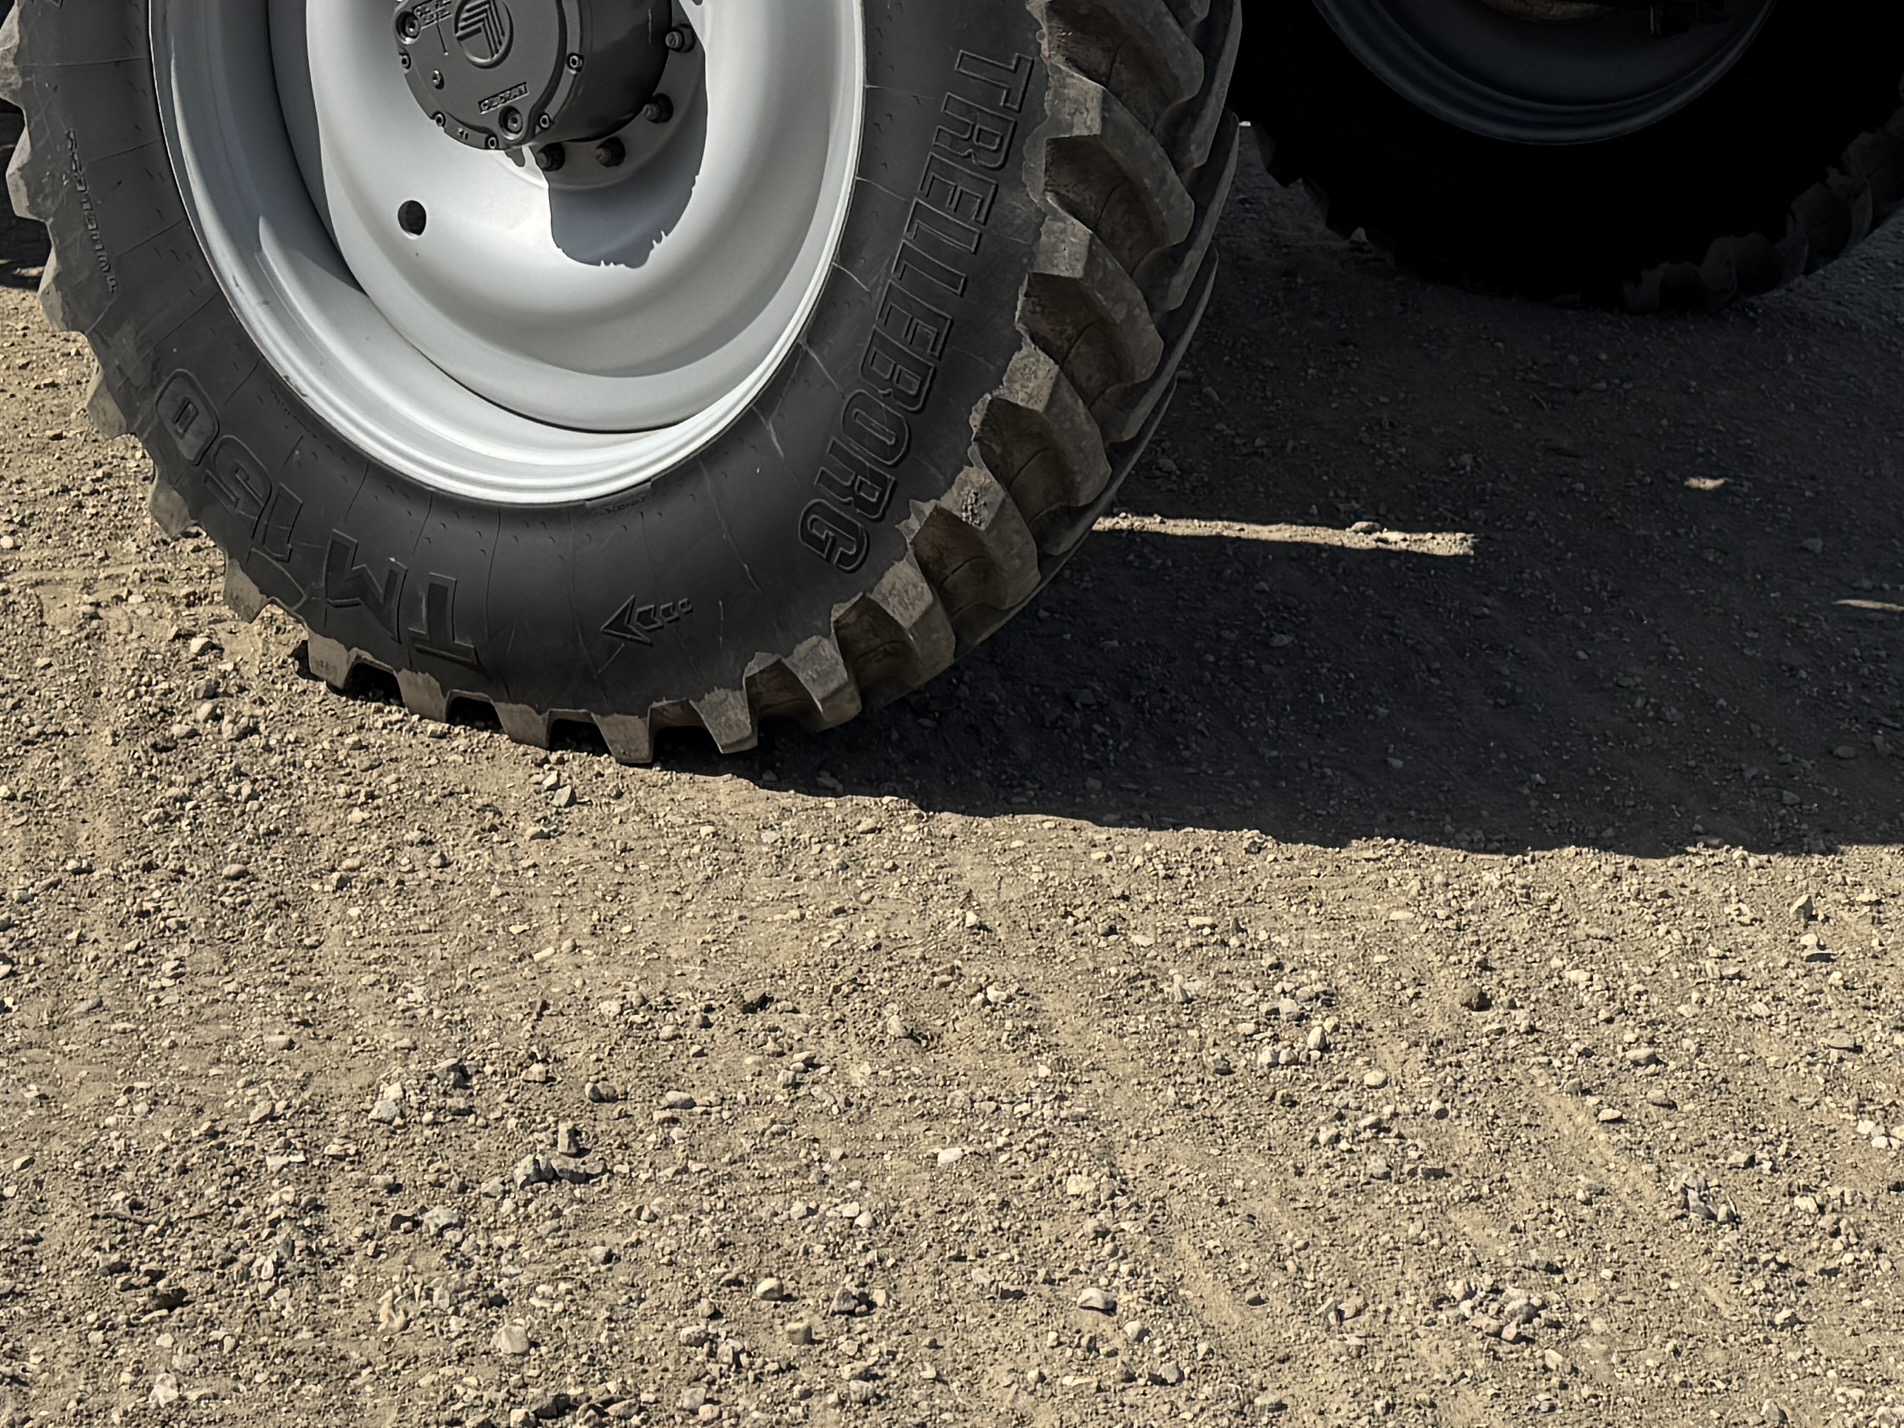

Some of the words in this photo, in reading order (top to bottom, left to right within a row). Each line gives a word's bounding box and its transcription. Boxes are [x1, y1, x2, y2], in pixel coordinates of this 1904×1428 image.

[799, 48, 1034, 573] TRELLEBORG
[155, 367, 307, 606] 150
[323, 528, 486, 669] TM
